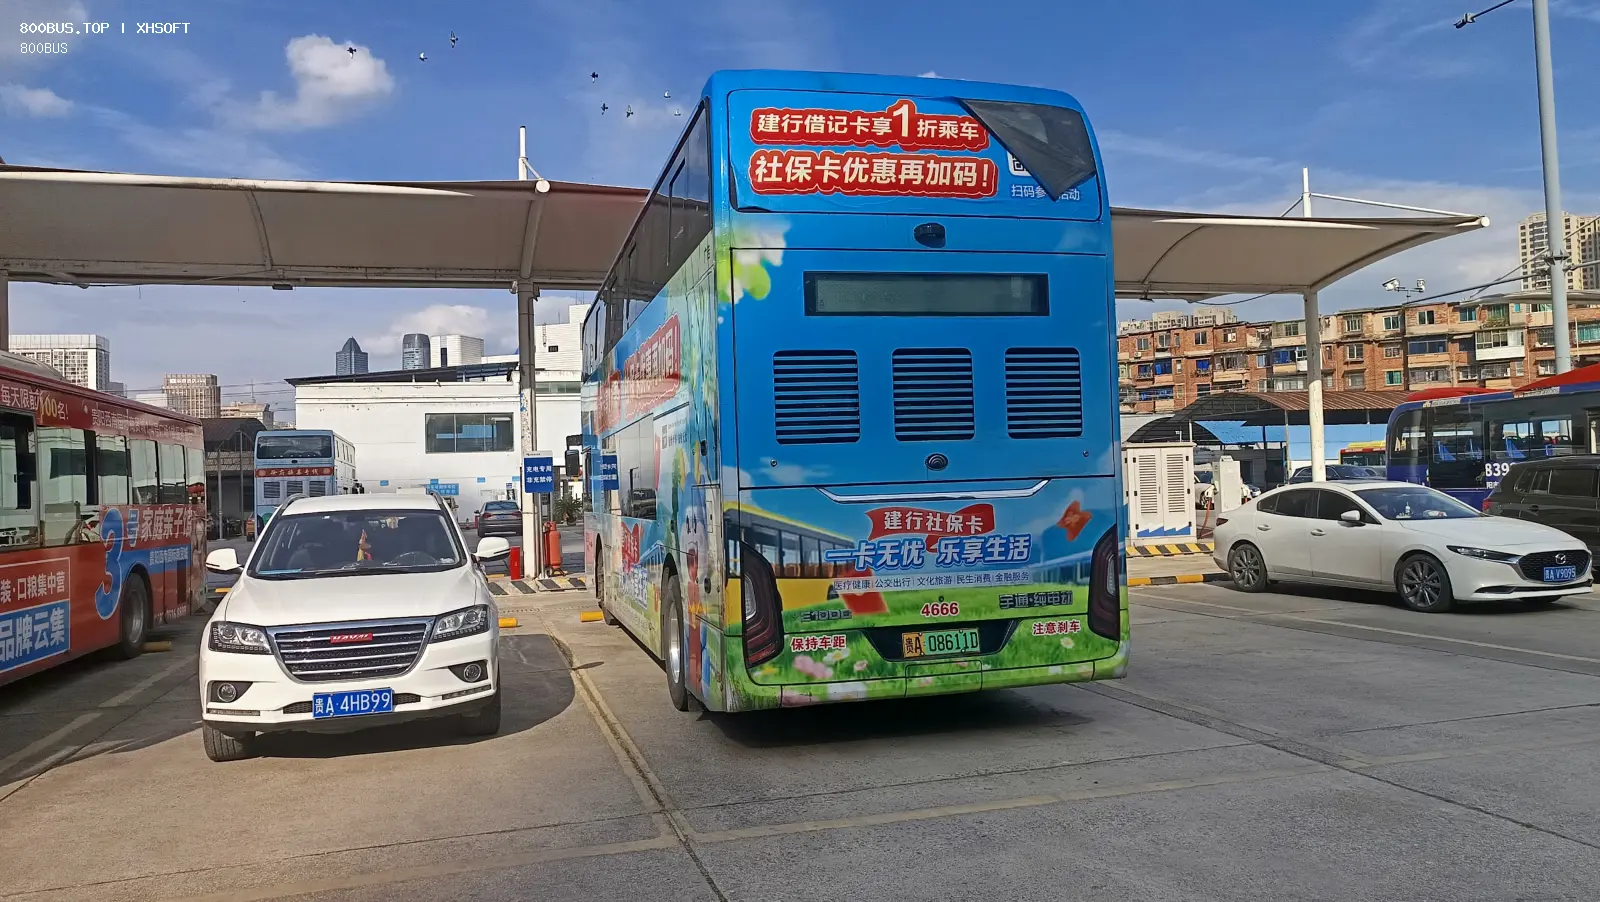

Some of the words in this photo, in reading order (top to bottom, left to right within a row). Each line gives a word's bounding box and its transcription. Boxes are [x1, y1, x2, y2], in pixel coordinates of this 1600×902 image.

[757, 104, 979, 141] 建行借记卡享1折乘车
[526, 465, 552, 473] 充电专用
[1485, 462, 1516, 477] 839
[883, 510, 984, 535] 建行社保卡
[825, 538, 926, 569] 一卡无忧
[936, 534, 1032, 566] 乐享生活
[834, 579, 871, 591] 医疗健康
[875, 577, 912, 589] 公交出行
[916, 575, 953, 587] 文化旅游
[956, 573, 992, 584] 民生消费
[995, 571, 1030, 583] 金融服务
[920, 602, 959, 617] 4666
[0, 606, 65, 662] 品牌云集
[1032, 620, 1081, 635] 注意刹车
[790, 635, 847, 651] 保持车距
